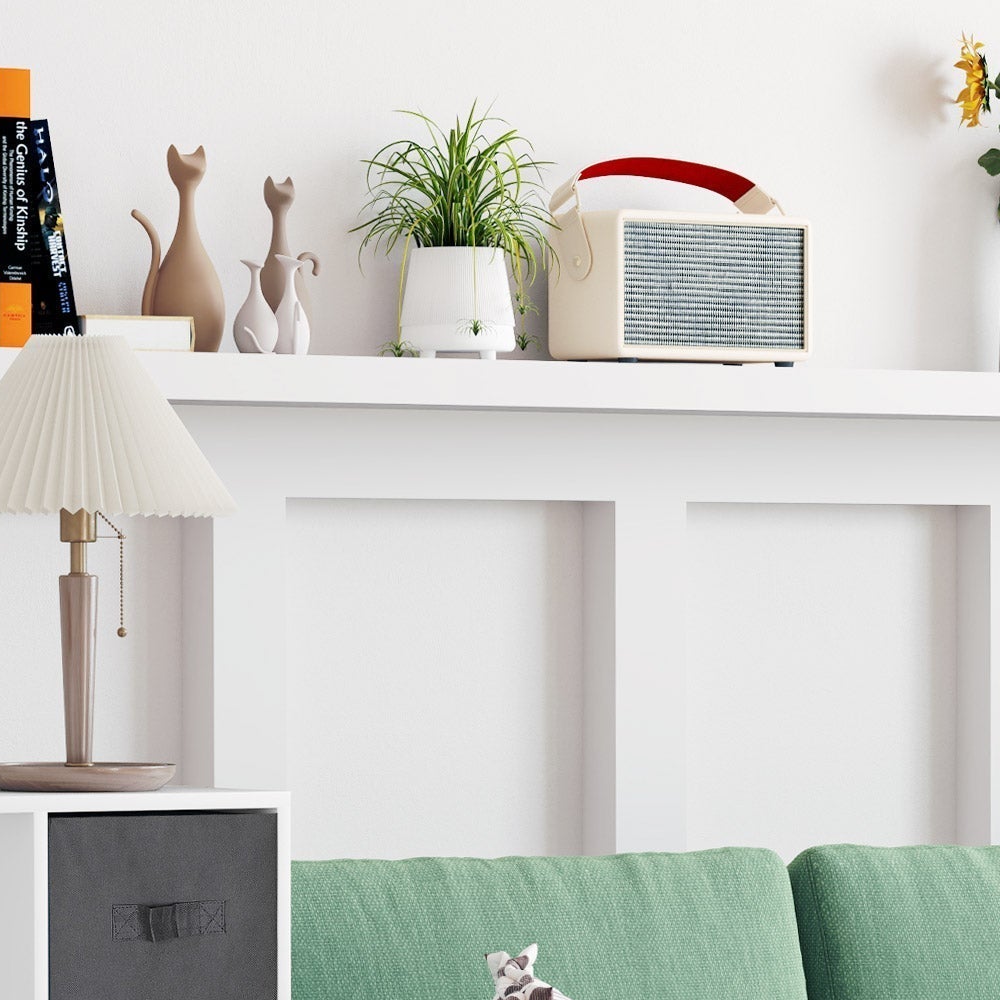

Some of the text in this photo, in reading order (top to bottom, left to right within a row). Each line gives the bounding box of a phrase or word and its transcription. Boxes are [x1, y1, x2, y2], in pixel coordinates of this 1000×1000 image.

[16, 121, 28, 141] the
[16, 143, 28, 186] Genius
[34, 126, 54, 205] HALO
[16, 188, 28, 204] of
[14, 205, 28, 251] Kinship
[47, 235, 62, 278] HARVEST
[53, 230, 67, 274] CONTACT
